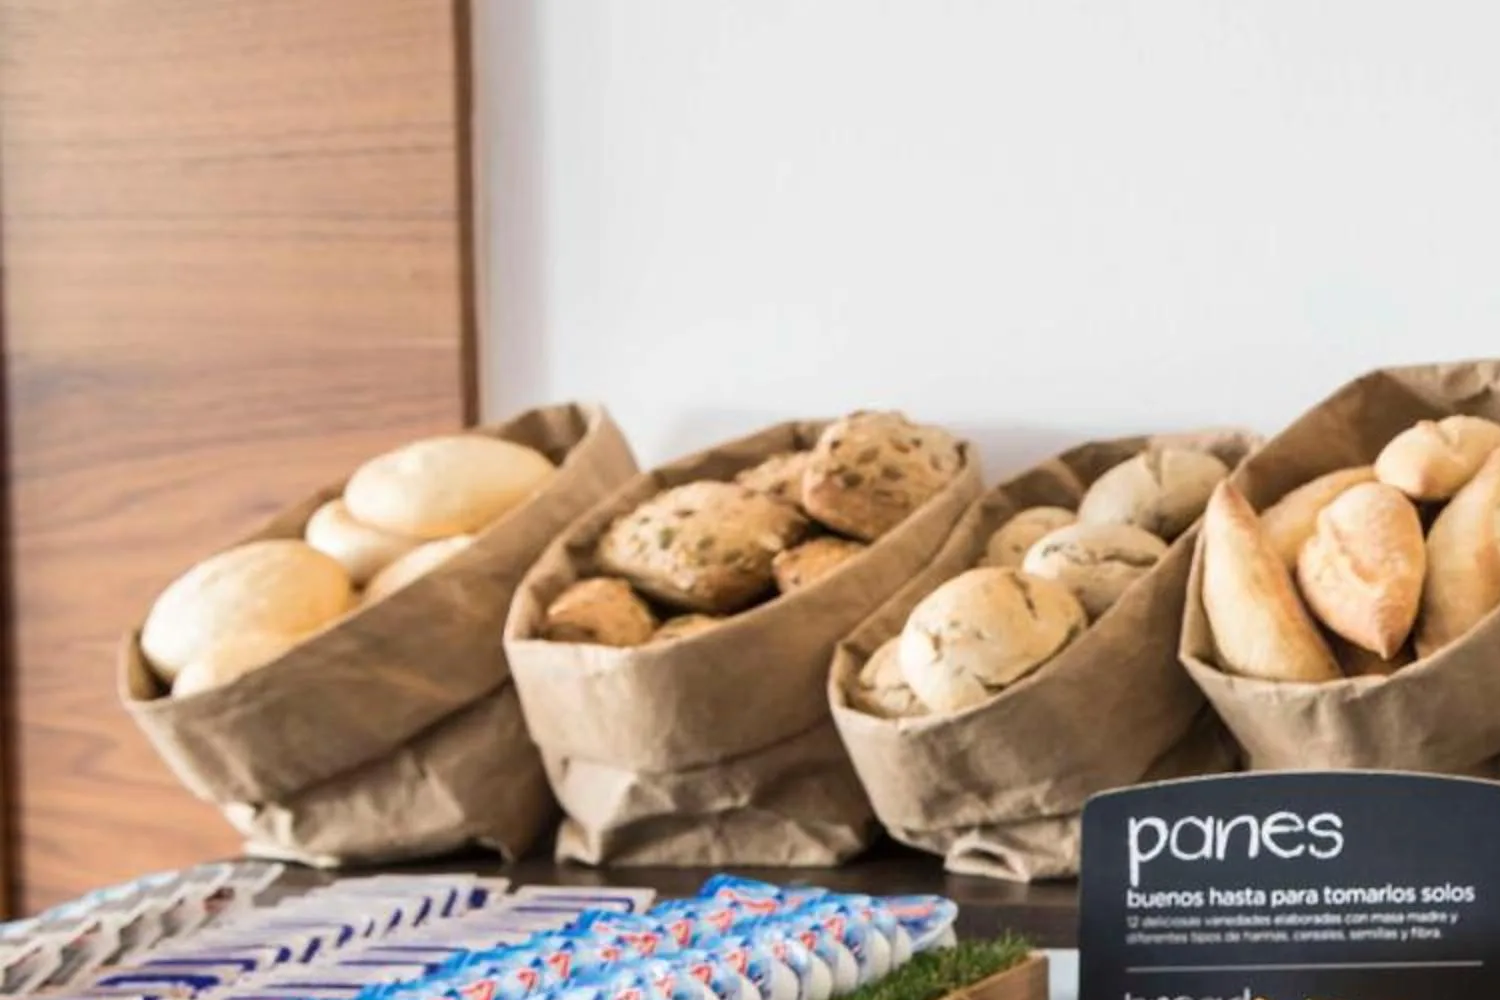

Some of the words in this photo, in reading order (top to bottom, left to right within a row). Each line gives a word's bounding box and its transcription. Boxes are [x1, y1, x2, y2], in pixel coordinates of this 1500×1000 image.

[1127, 811, 1344, 886] panes
[1126, 889, 1204, 908] buenos
[1209, 886, 1267, 906] hasta
[1271, 889, 1319, 908] para
[1323, 884, 1417, 905] tomarlos
[1421, 882, 1475, 903] solos
[1204, 915, 1271, 927] variedades
[1344, 913, 1369, 925] con
[1406, 911, 1448, 923] madre
[1224, 931, 1240, 942] de
